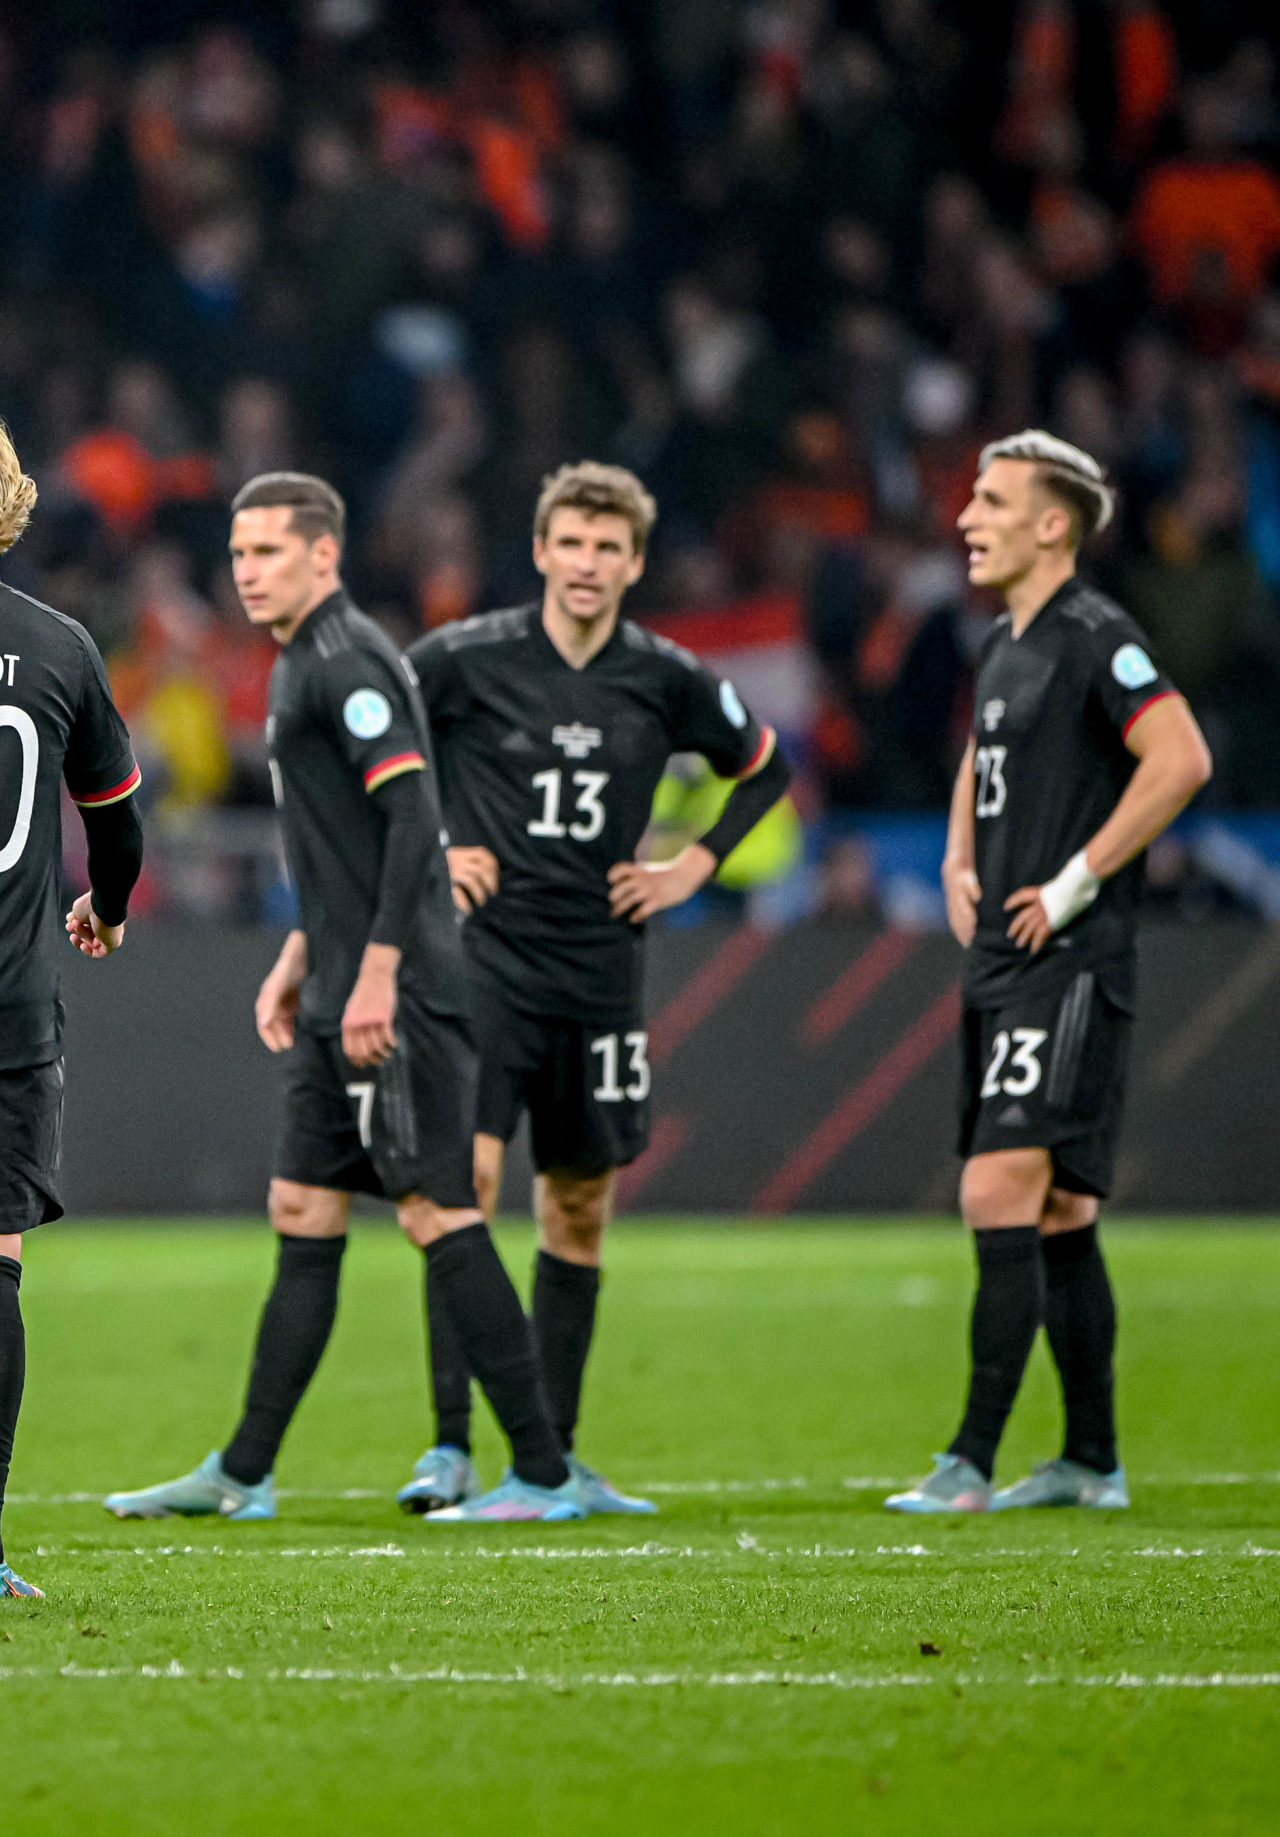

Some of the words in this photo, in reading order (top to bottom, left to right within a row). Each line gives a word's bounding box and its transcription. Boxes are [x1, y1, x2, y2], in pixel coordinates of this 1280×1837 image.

[527, 768, 610, 842] 13
[591, 1031, 652, 1101] 13
[980, 1027, 1049, 1099] 23
[346, 1083, 375, 1149] 7
